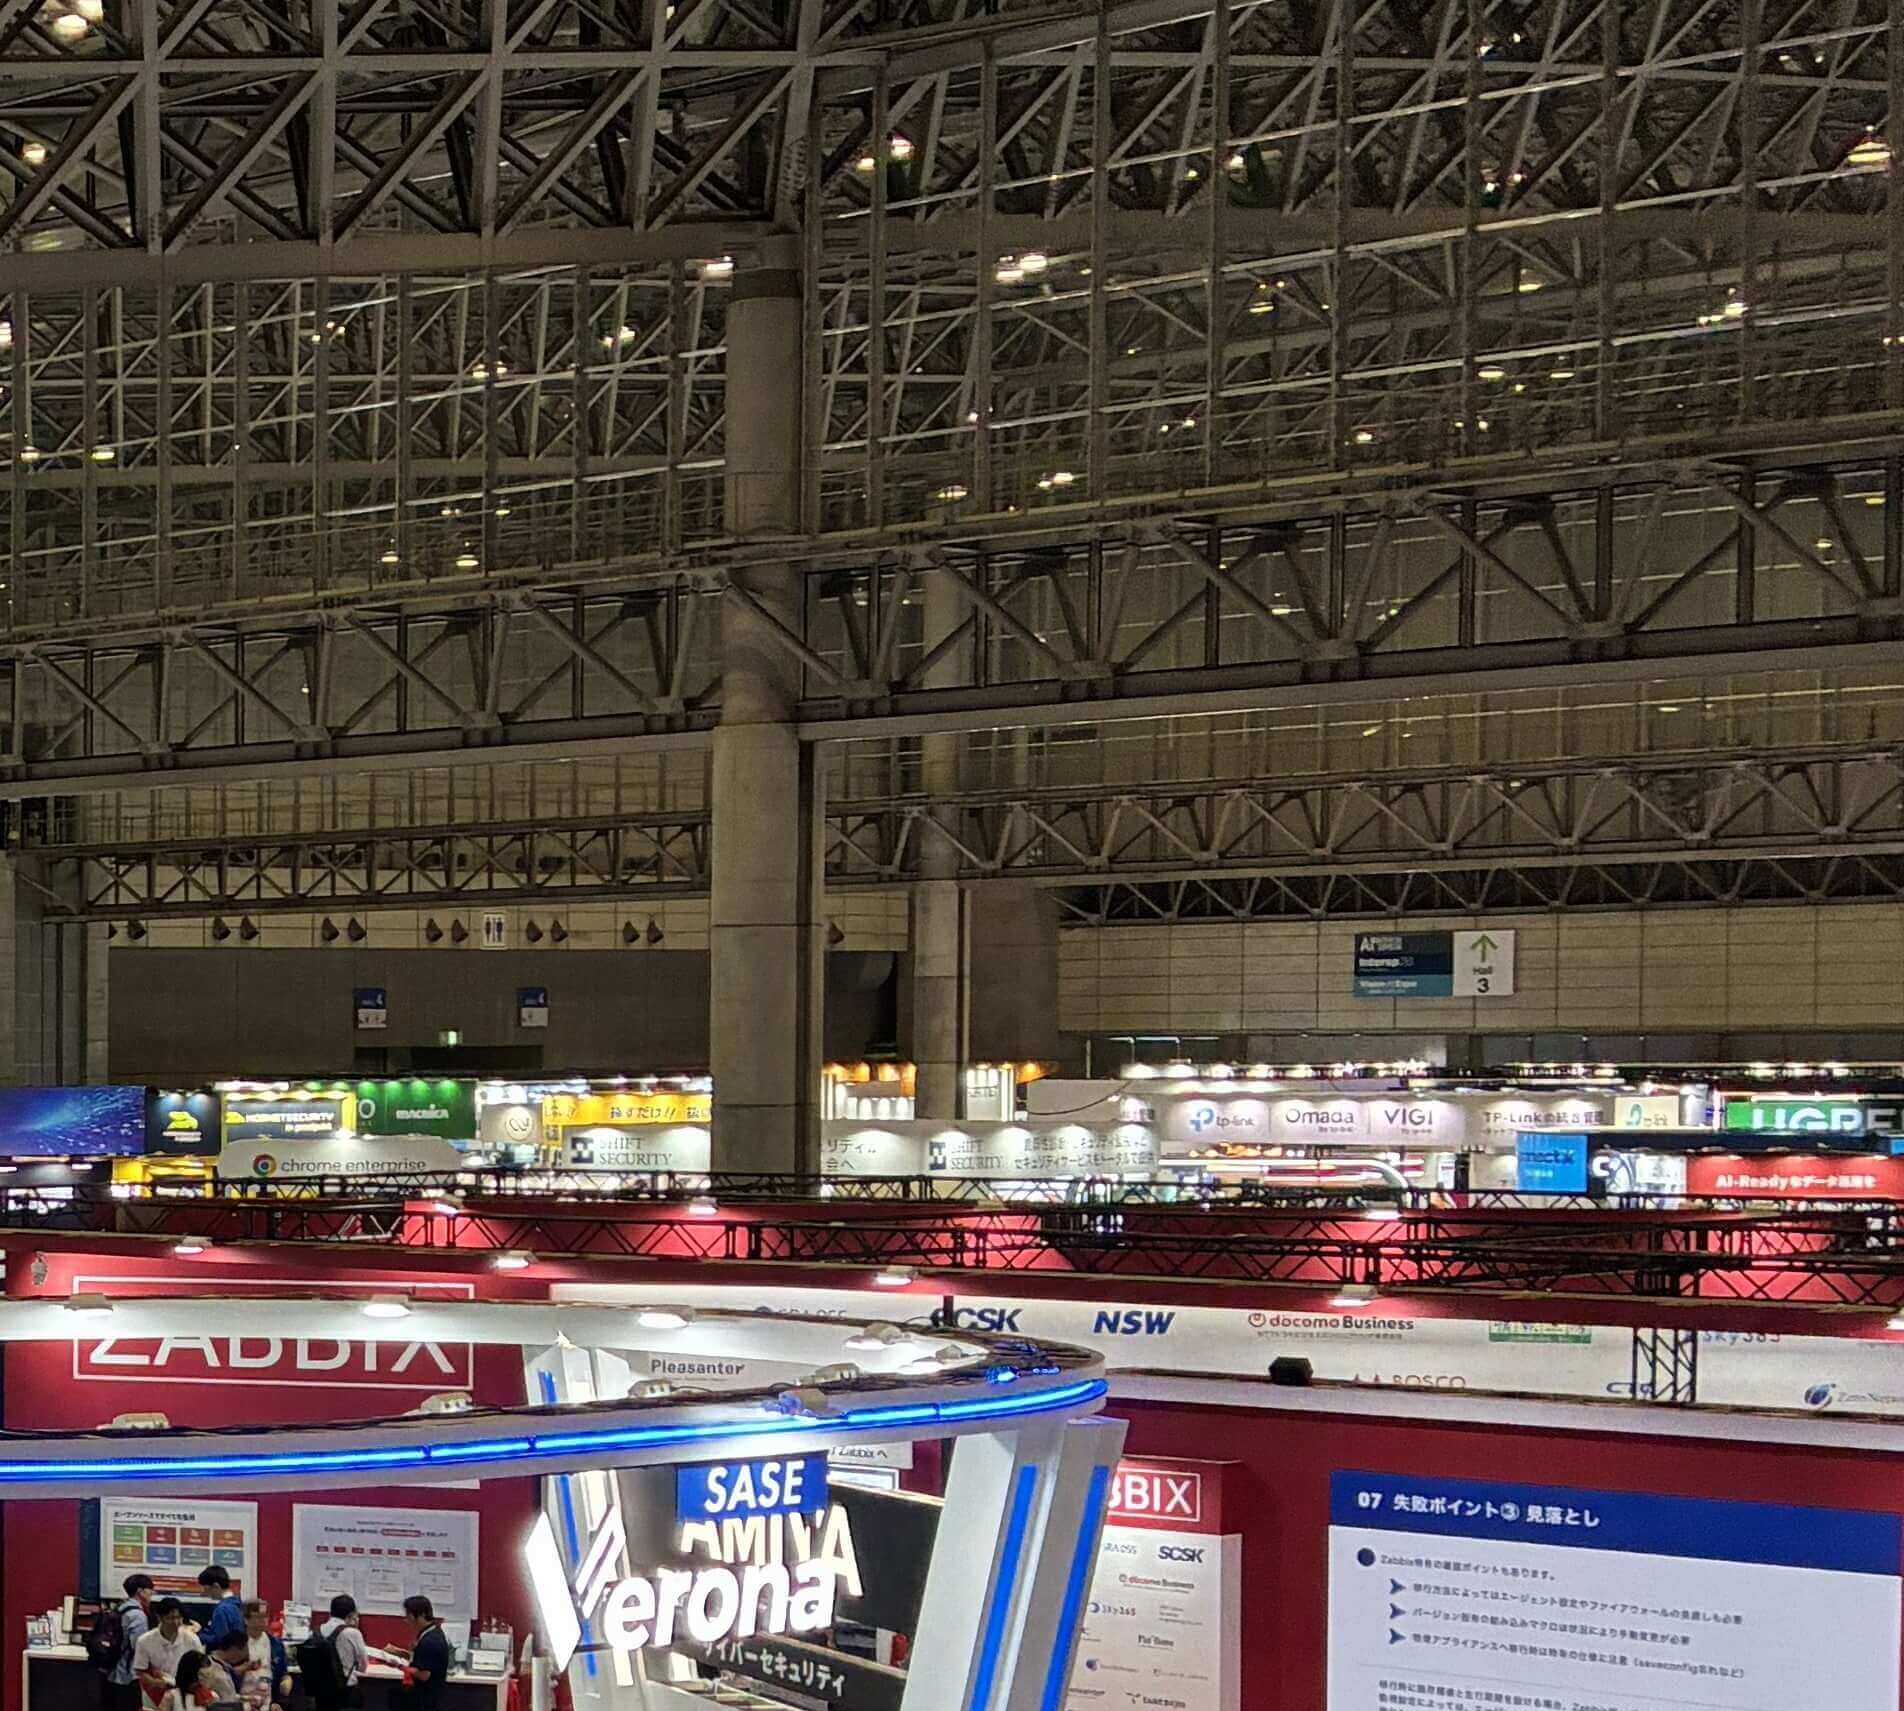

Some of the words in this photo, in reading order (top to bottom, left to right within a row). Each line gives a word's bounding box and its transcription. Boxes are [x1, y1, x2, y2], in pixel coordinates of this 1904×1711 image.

[1477, 977, 1490, 993] 3
[1285, 1107, 1354, 1125] Omada
[1385, 1108, 1433, 1126] VIGI
[598, 1137, 645, 1150] SHIFT
[280, 1158, 343, 1173] chrome
[345, 1159, 426, 1175] enterprise
[598, 1152, 673, 1167] SECURITY
[1092, 1310, 1176, 1336] NSW
[1269, 1314, 1339, 1330] docomo
[1342, 1316, 1415, 1331] Business
[649, 1358, 745, 1378] Pleasanter
[703, 1460, 806, 1514] SASE
[1357, 1491, 1383, 1509] 07
[1392, 1495, 1521, 1523] 失敗ポイント③
[1526, 1504, 1601, 1528] 見落とし
[1158, 1545, 1204, 1564] SCSK
[524, 1504, 838, 1674] Verona
